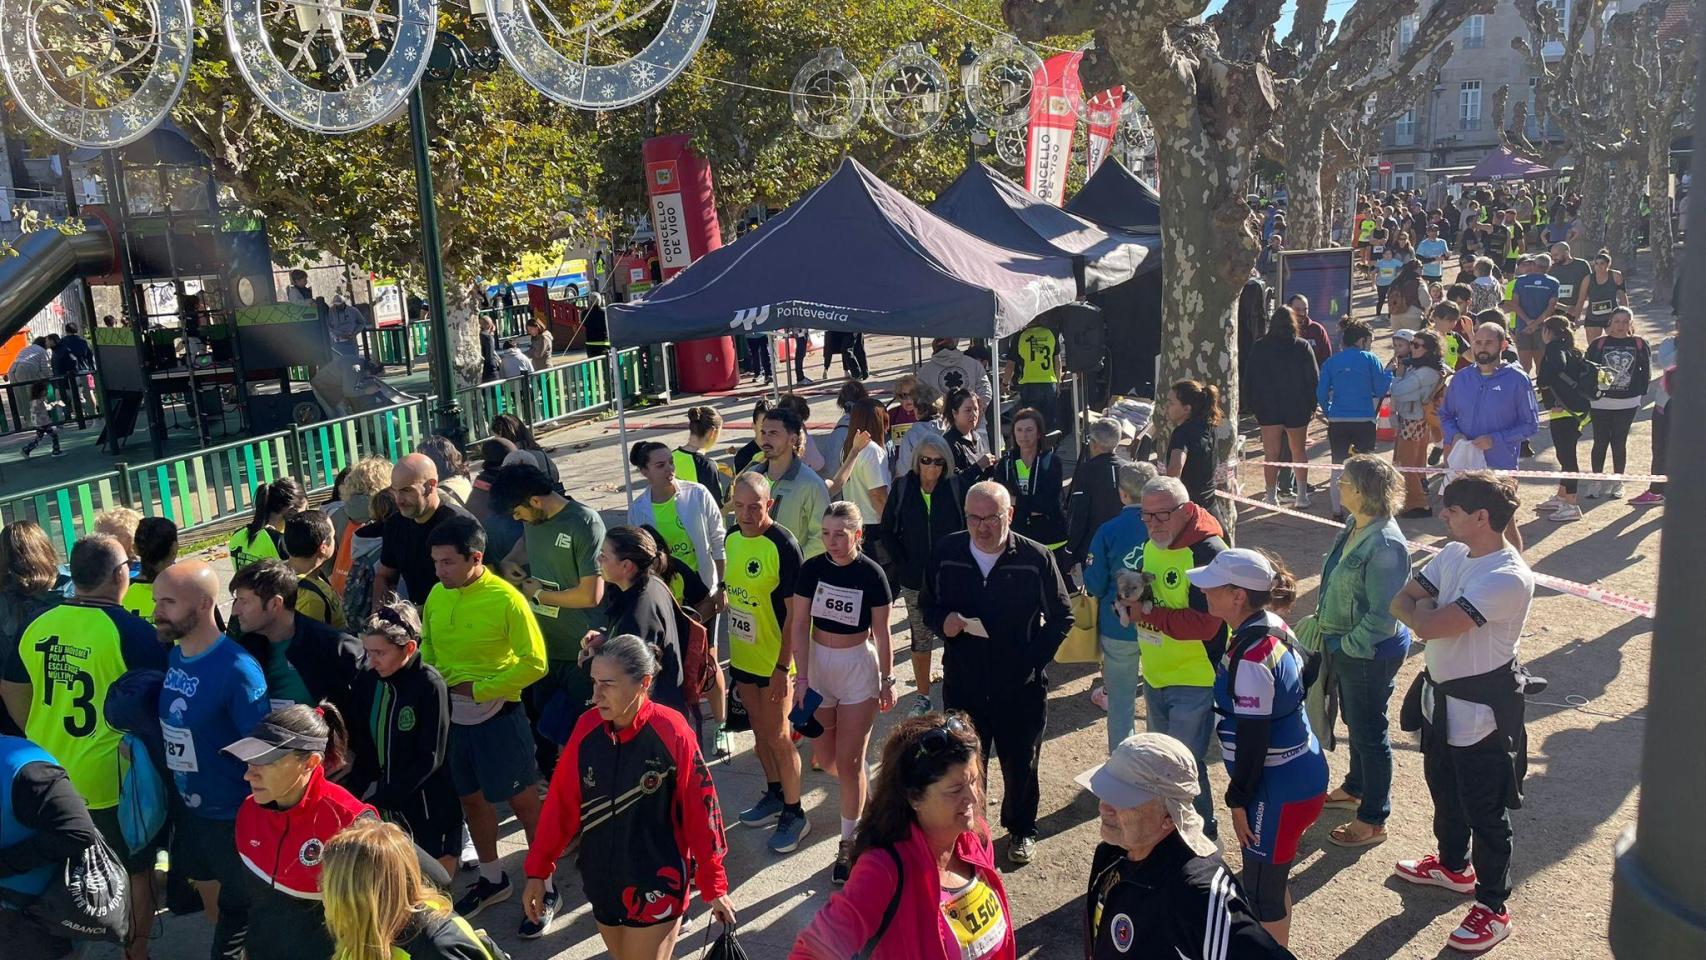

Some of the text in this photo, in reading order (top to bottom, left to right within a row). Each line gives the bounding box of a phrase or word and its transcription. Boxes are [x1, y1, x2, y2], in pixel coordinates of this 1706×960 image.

[1038, 134, 1050, 198] ONCELLO
[657, 201, 673, 263] CONCELLO
[667, 207, 682, 254] DE VIGO
[777, 306, 848, 322] Pontevedra
[727, 584, 748, 599] EMPO
[825, 598, 853, 613] 686
[732, 617, 751, 632] 748
[48, 653, 66, 663] POLA
